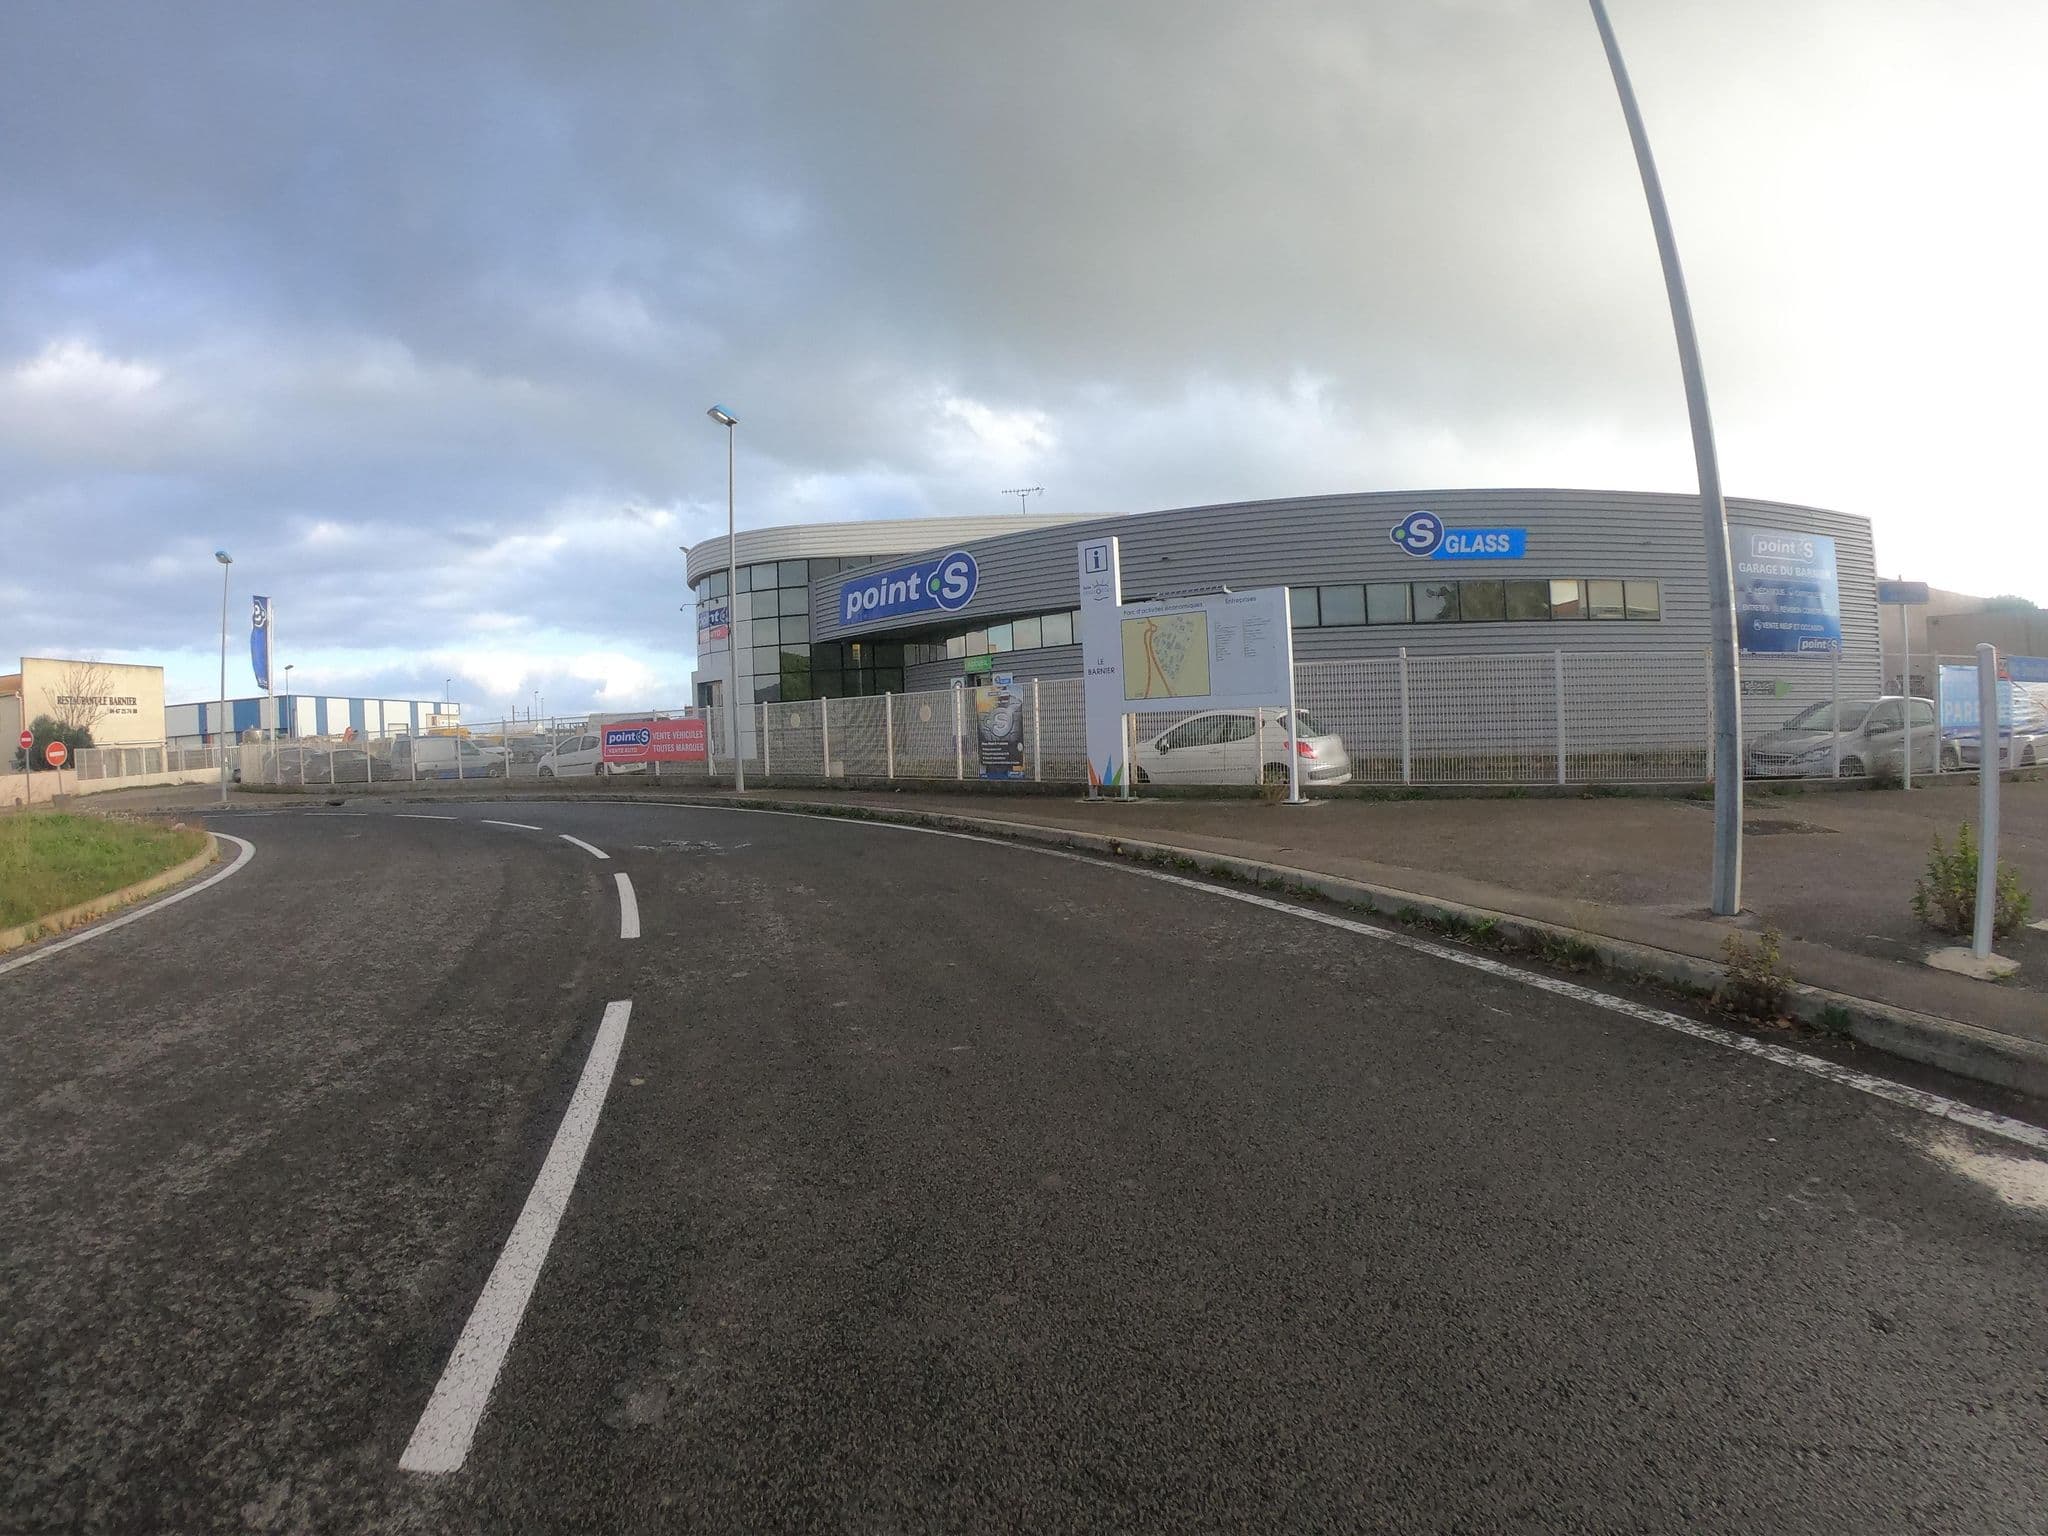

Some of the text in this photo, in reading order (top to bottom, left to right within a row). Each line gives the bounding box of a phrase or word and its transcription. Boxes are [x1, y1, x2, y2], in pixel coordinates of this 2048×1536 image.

[1407, 518, 1510, 553] S GLASS
[1758, 539, 1814, 558] point S
[1738, 562, 1778, 576] GARAGE
[1780, 566, 1793, 576] DU
[846, 561, 969, 619] point S
[1802, 640, 1827, 650] point
[1088, 667, 1115, 676] BARNIER
[109, 697, 138, 706] BARNIER
[608, 730, 650, 744] point S
[652, 731, 671, 740] VENTE
[652, 743, 705, 752] TOUTES MARQUES
